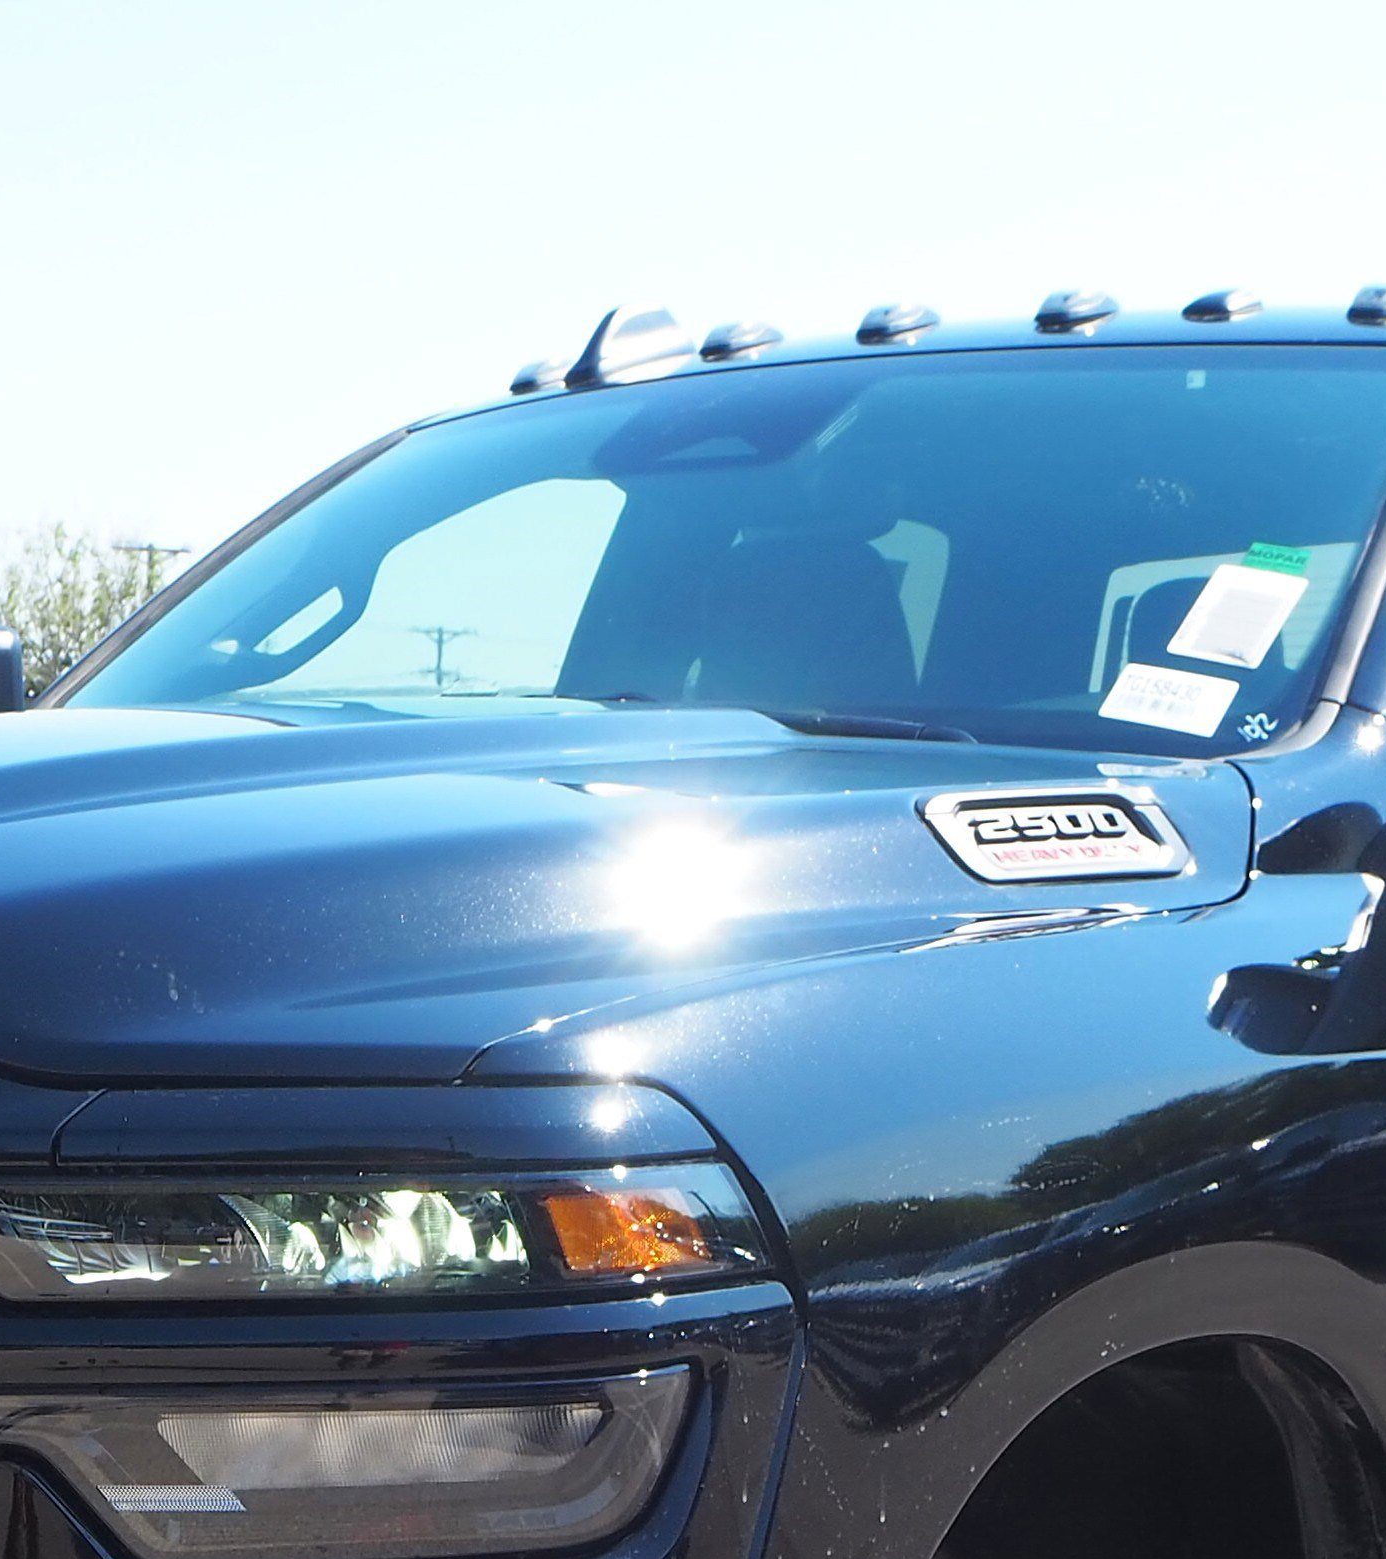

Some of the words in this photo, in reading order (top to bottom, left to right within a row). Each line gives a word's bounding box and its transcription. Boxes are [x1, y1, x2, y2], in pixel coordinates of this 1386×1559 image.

[1248, 549, 1307, 565] MOPAR
[968, 810, 1129, 847] 2500
[992, 847, 1075, 864] HEAVY
